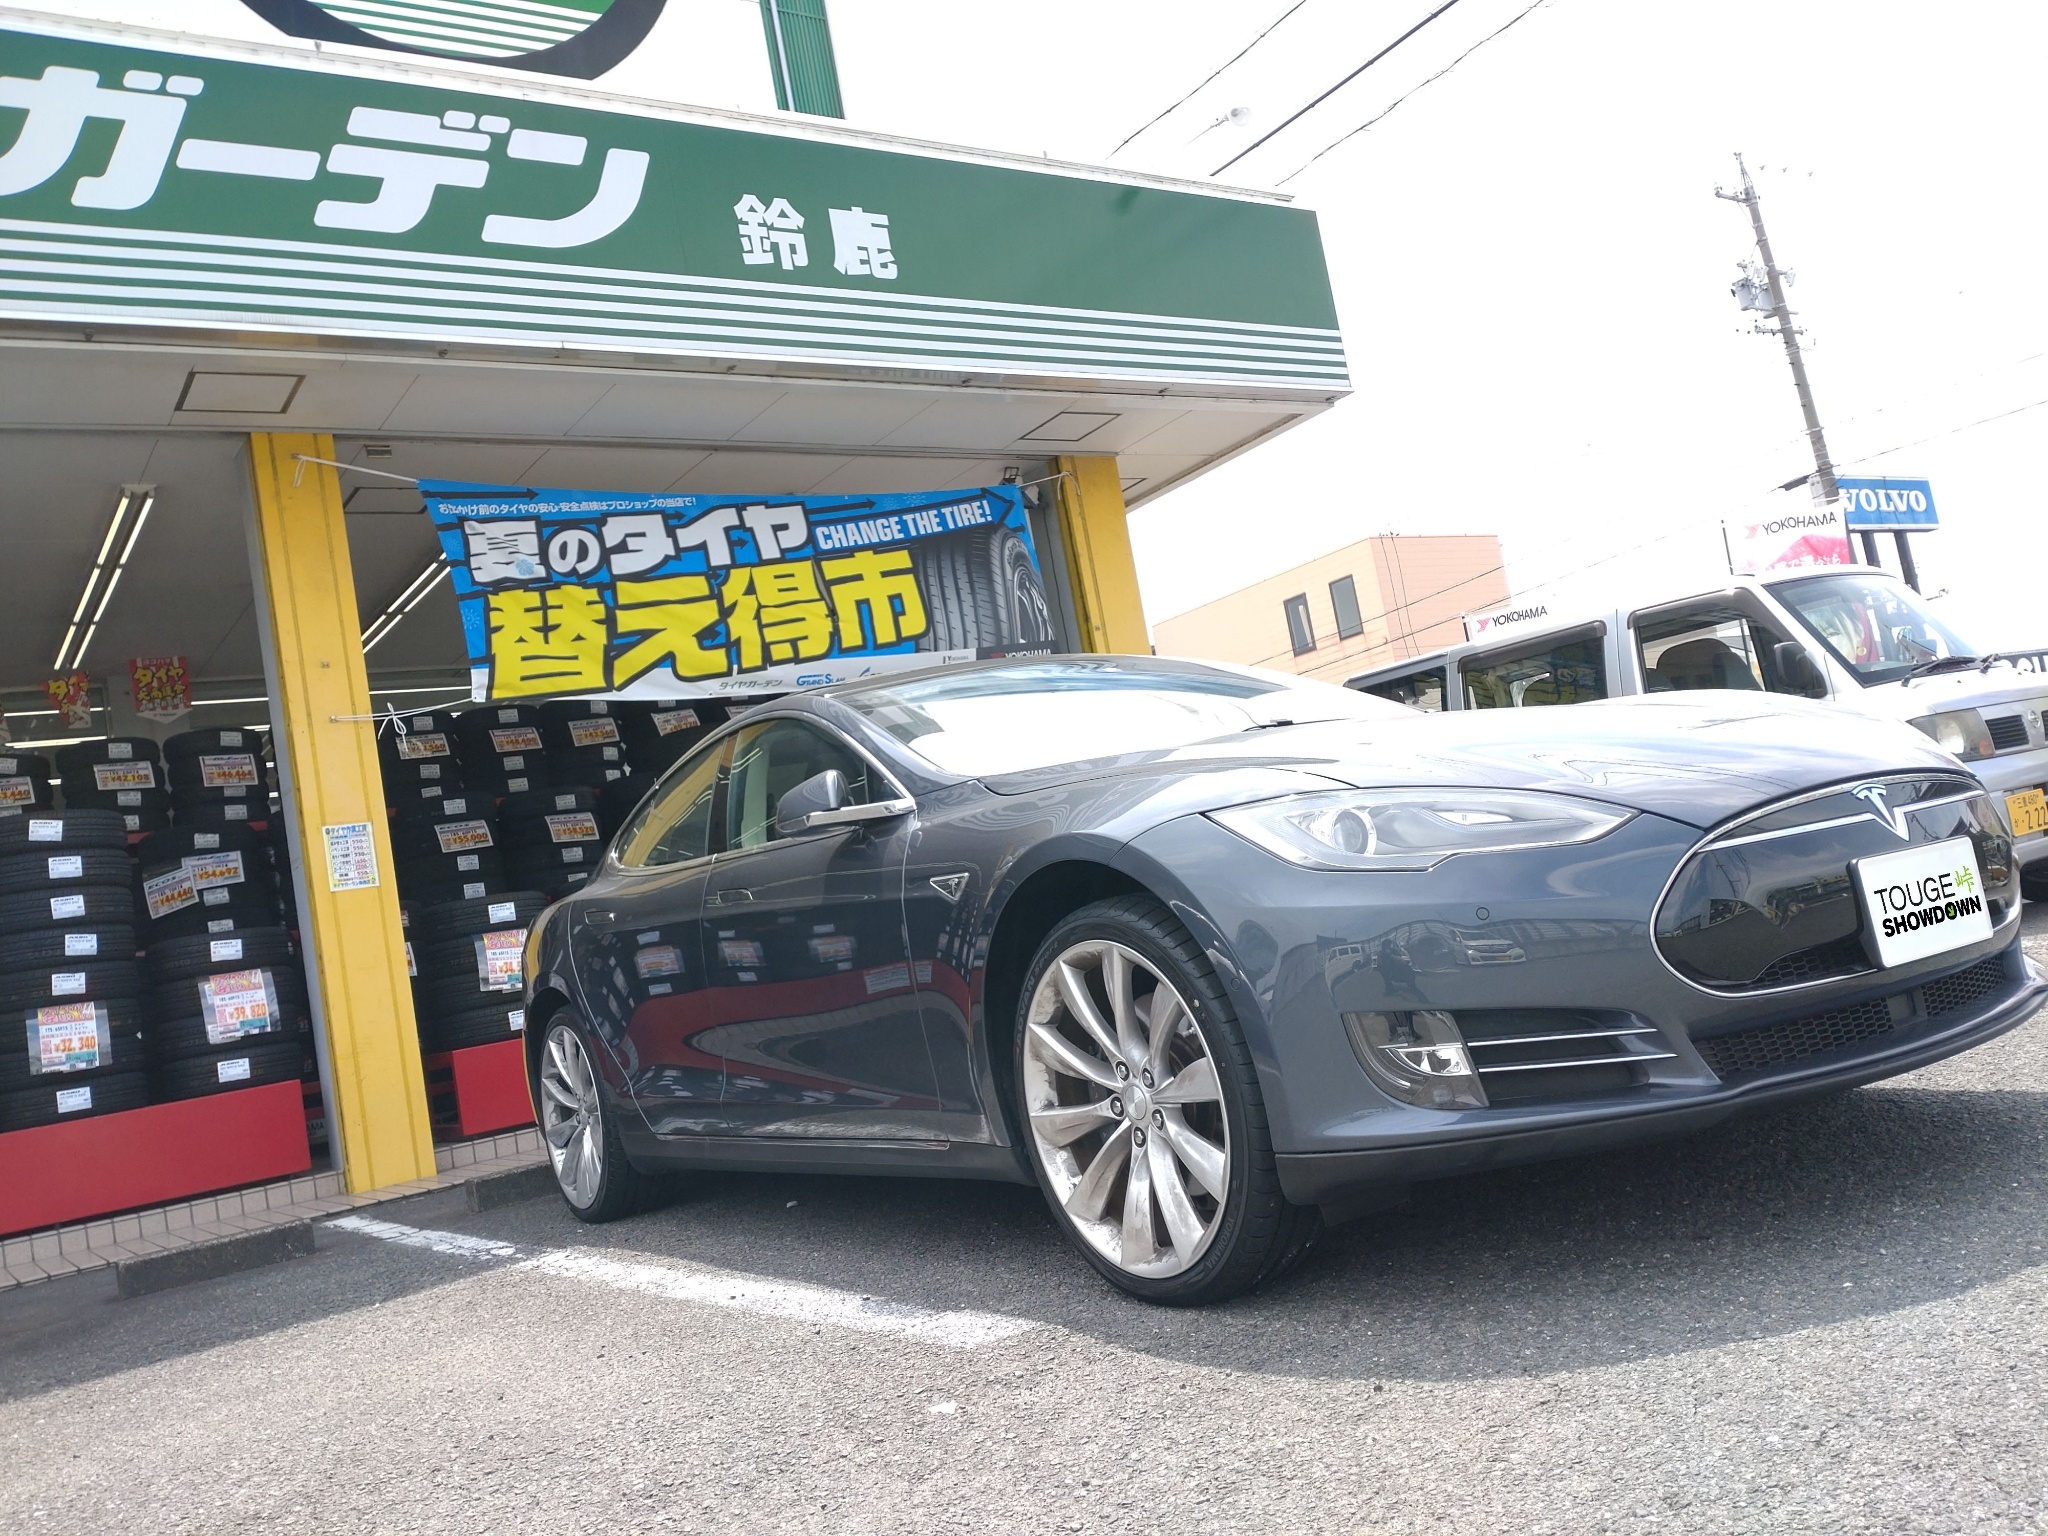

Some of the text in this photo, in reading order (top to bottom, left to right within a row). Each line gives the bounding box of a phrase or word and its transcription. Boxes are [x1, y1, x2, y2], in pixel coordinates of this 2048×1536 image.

[0, 66, 650, 248] ガーデン
[733, 194, 898, 280] 鈴鹿
[818, 500, 992, 550] CHANGE THE TIRE!
[1762, 511, 1838, 535] YOKOHAMA
[1841, 488, 1927, 513] VOLVO
[487, 548, 926, 700] 替え得市
[1492, 605, 1548, 627] YOKOHAMA
[1205, 1216, 1235, 1269] YOKOHAMA
